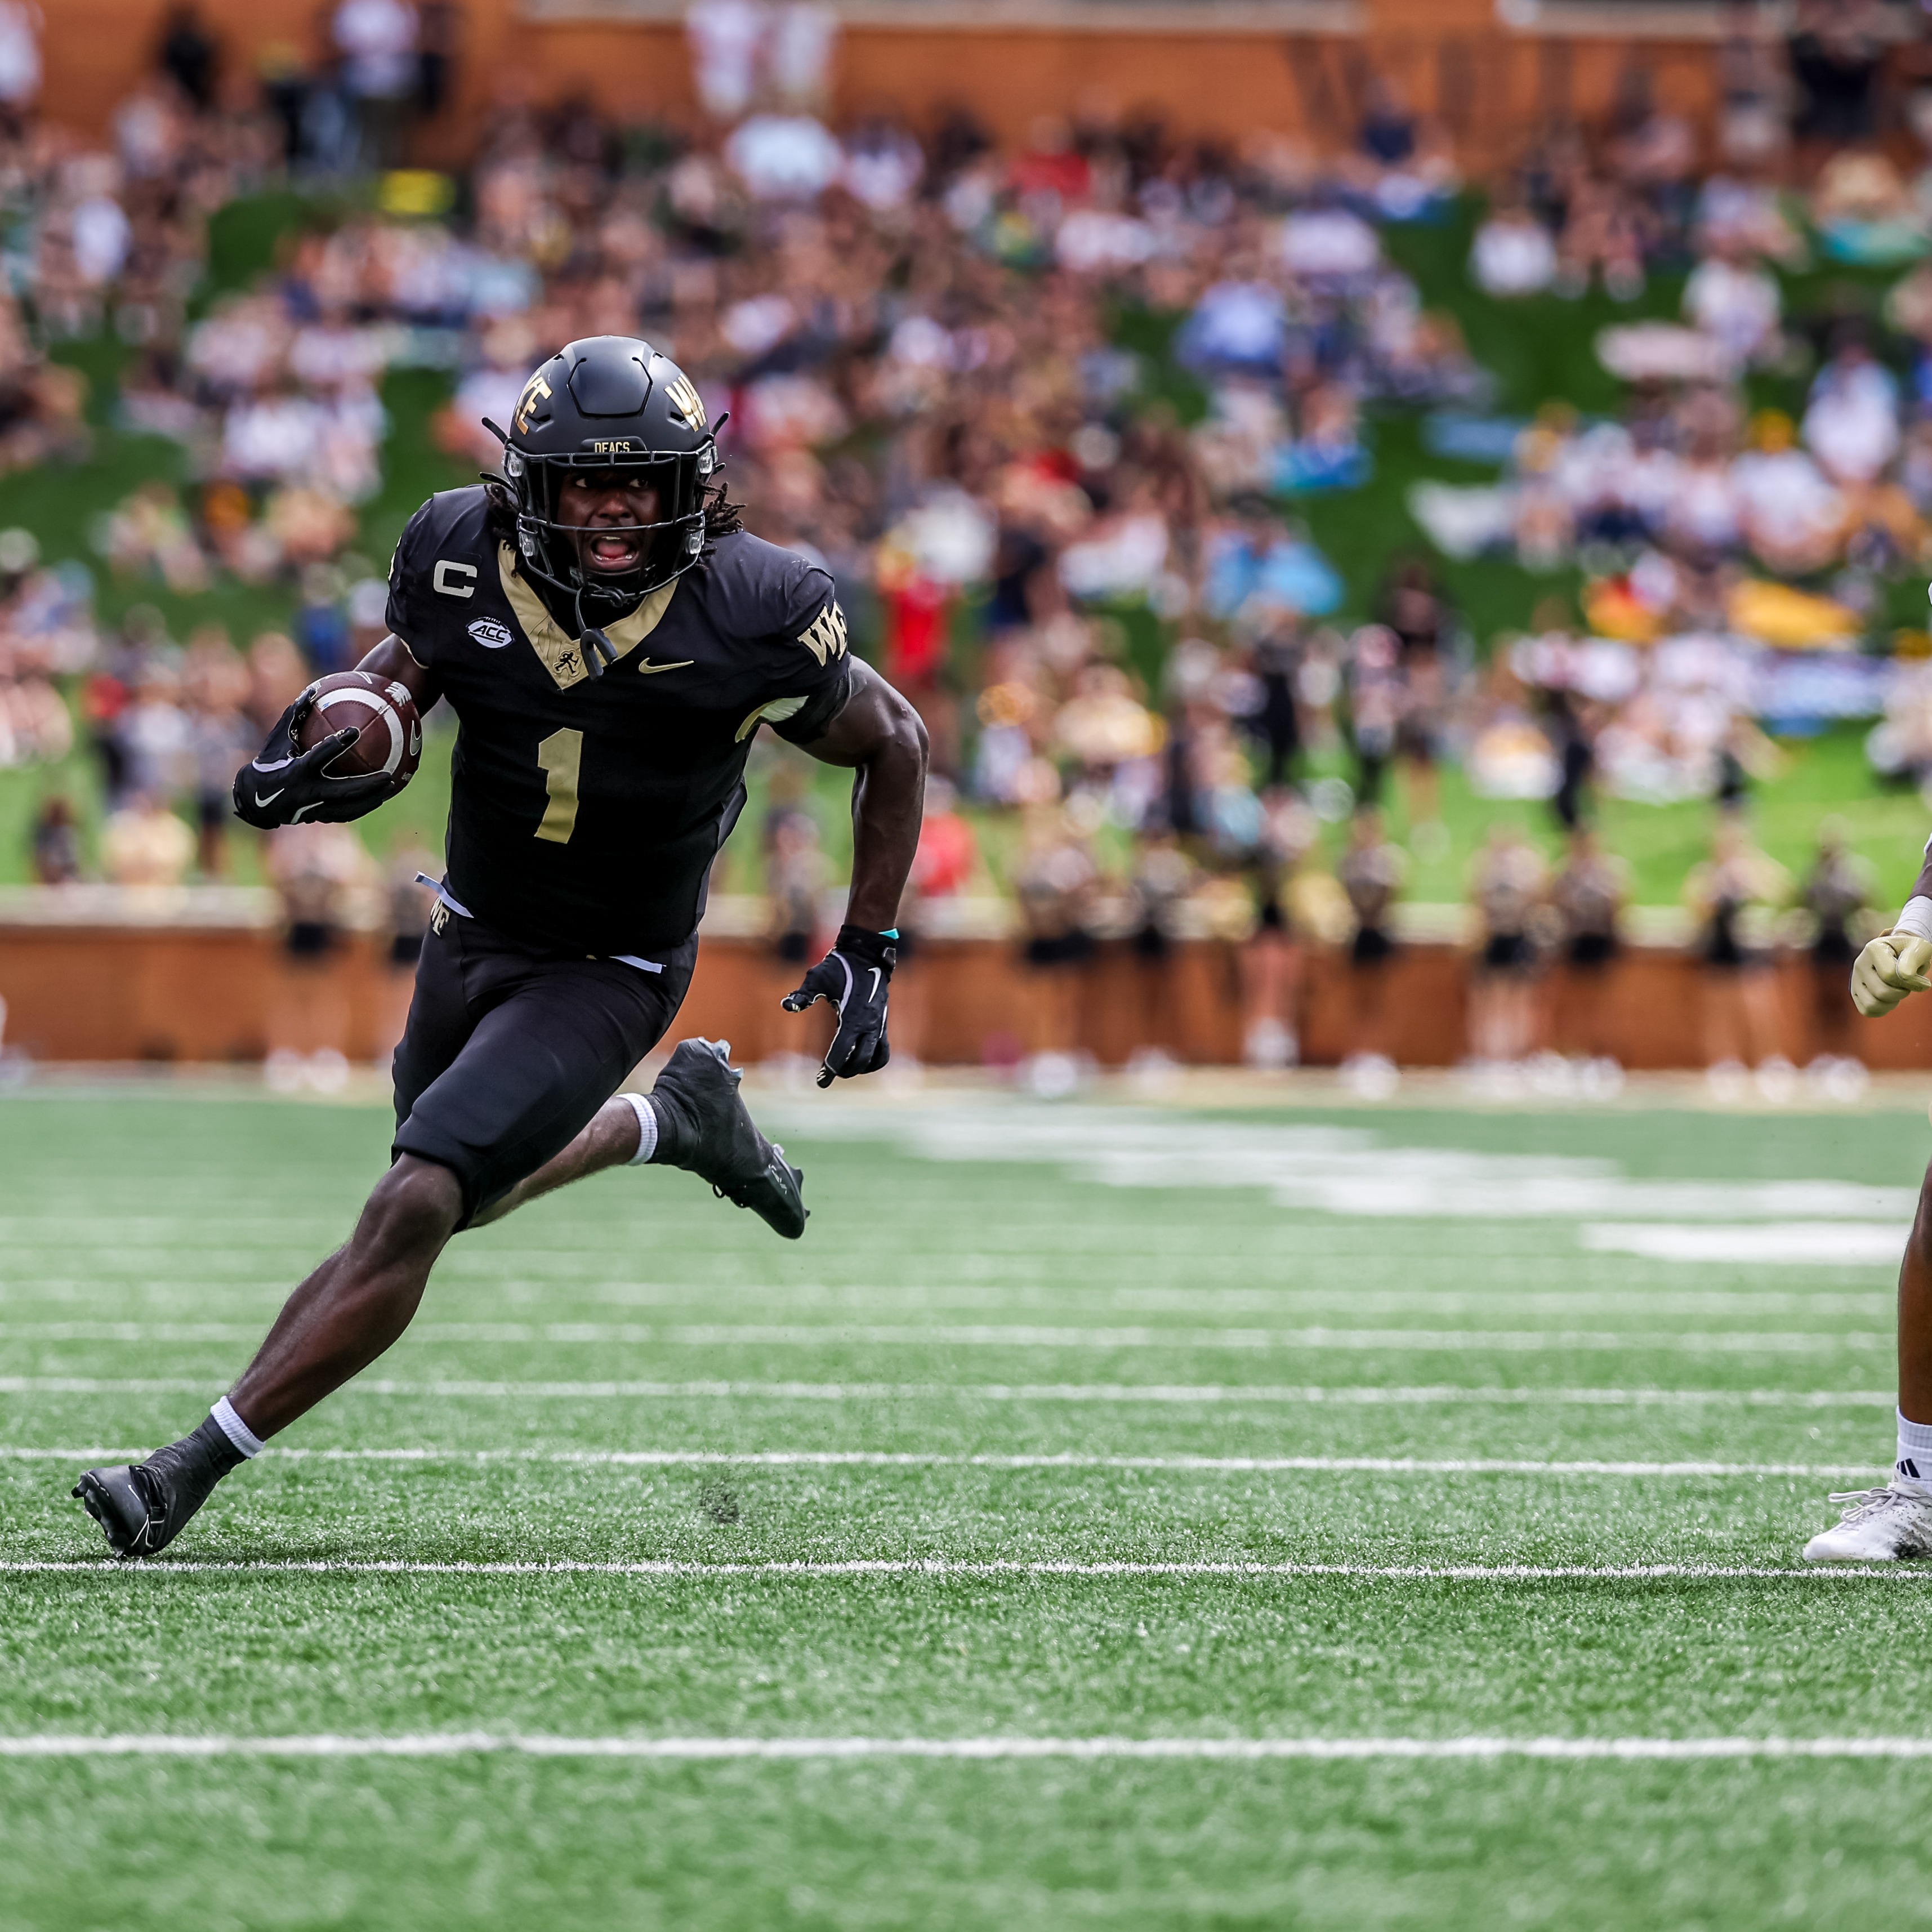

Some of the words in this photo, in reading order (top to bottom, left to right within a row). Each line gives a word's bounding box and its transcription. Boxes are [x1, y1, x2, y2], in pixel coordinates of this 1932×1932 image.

[595, 441, 630, 453] DEACS
[433, 560, 478, 598] C
[472, 624, 508, 641] ACC
[534, 727, 584, 844] 1
